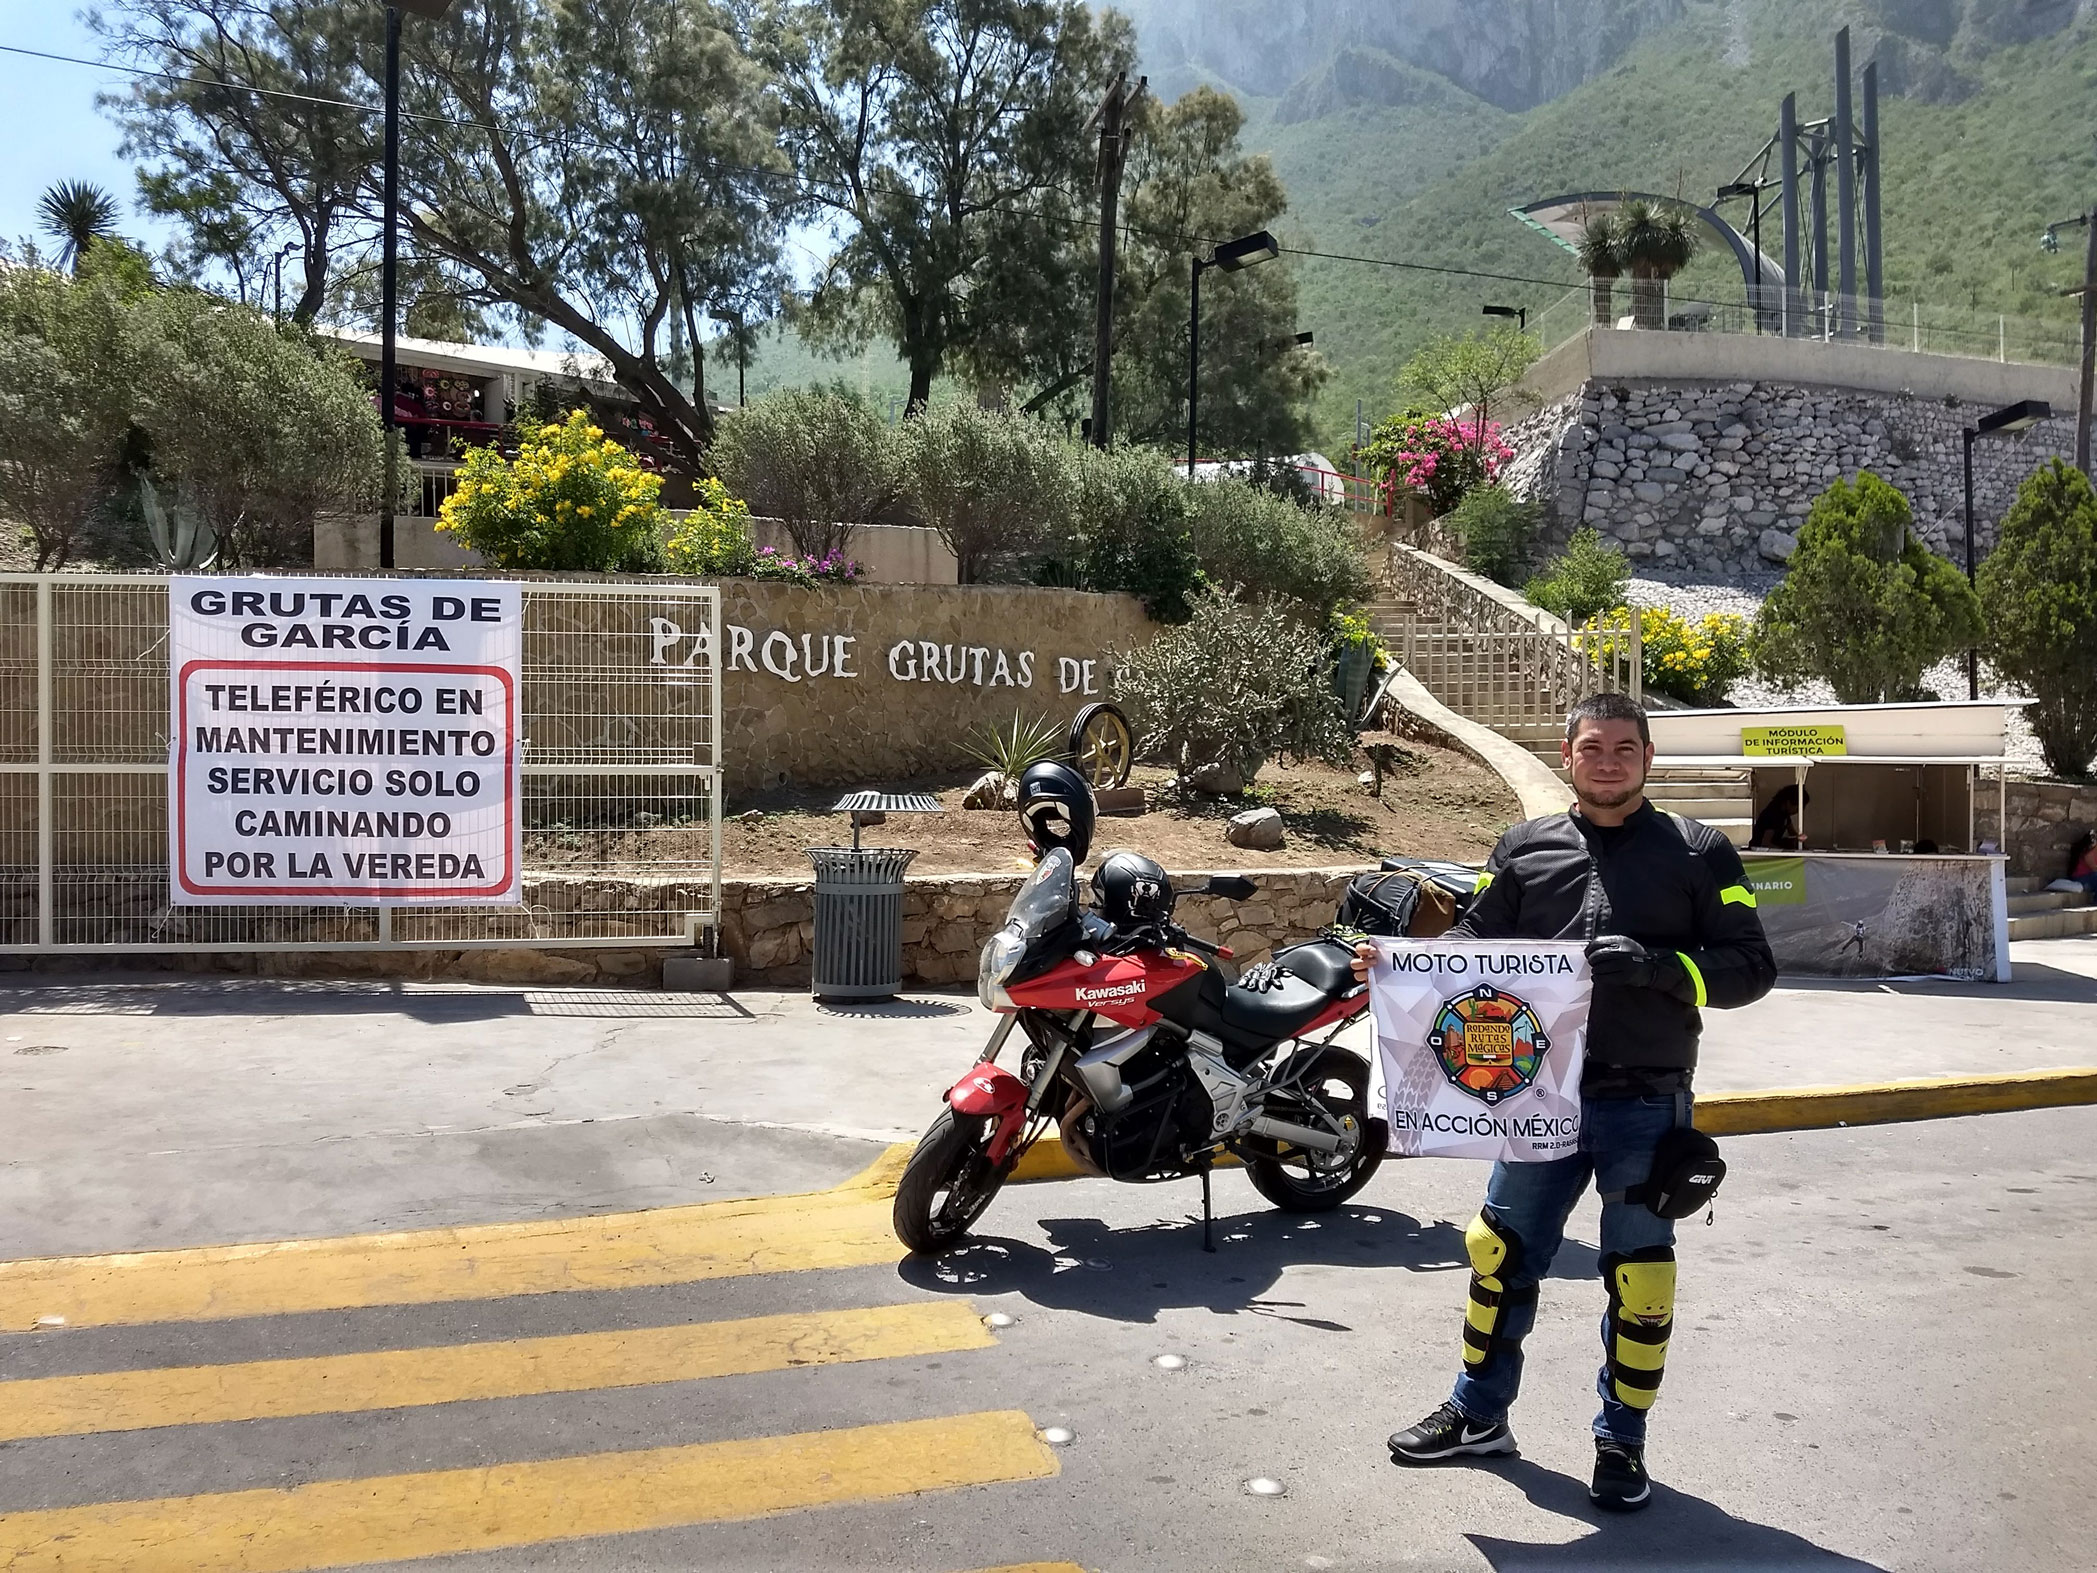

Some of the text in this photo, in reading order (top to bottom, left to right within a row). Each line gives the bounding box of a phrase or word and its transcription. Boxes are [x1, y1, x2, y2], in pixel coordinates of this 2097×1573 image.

[191, 591, 501, 622] GRUTAS DE
[241, 621, 450, 651] GARCÍA
[650, 617, 858, 683] PARQUE
[889, 640, 1035, 689] GRUTAS
[1059, 657, 1099, 696] DE
[205, 680, 482, 715] TELEFÉRICO EN
[196, 727, 496, 757] MANTENIMIENTO
[1762, 736, 1844, 746] INFORMACIÓN
[1769, 728, 1818, 737] MÓDULO
[1766, 746, 1824, 755] TURÍSTICA
[207, 768, 480, 797] SERVICIO SOLO
[235, 810, 451, 838] CAMINANDO
[205, 852, 485, 880] POR LA VEREDA
[1392, 952, 1574, 974] MOTO TURISTA
[1075, 979, 1146, 1001] Kawasaki
[1479, 989, 1492, 998] N
[1088, 997, 1135, 1007] Versys
[1536, 1040, 1546, 1048] E
[1486, 1092, 1498, 1100] S
[1395, 1110, 1578, 1137] EN ACCIÓN MÉXICO
[1532, 1142, 1549, 1150] RRM
